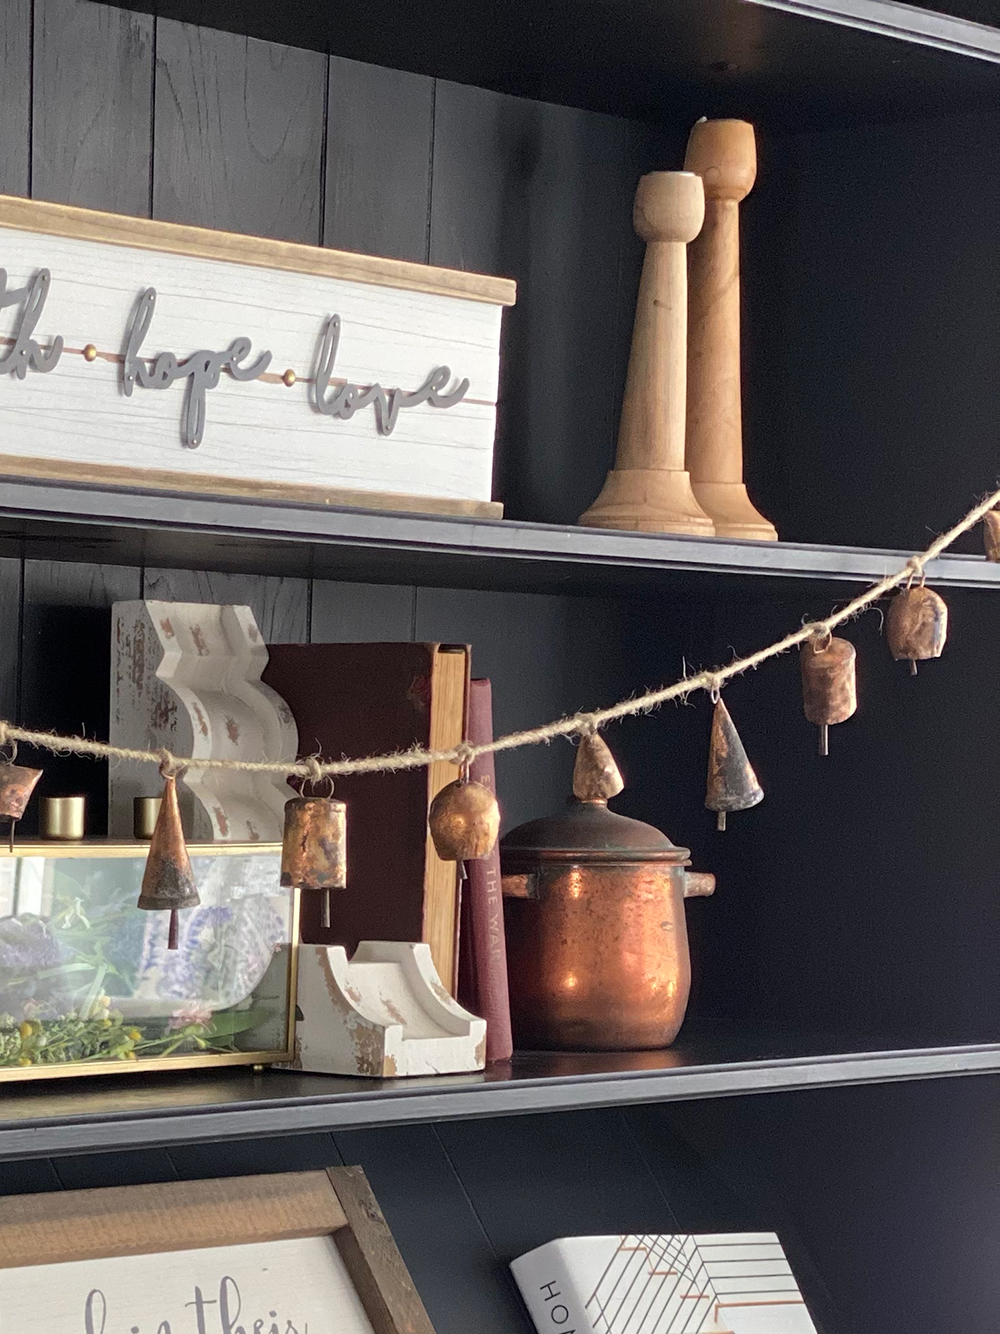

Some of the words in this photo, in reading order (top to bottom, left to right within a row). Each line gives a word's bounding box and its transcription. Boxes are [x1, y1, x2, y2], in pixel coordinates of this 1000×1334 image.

[122, 286, 273, 450] hope
[314, 313, 470, 436] love
[486, 867, 498, 905] THE
